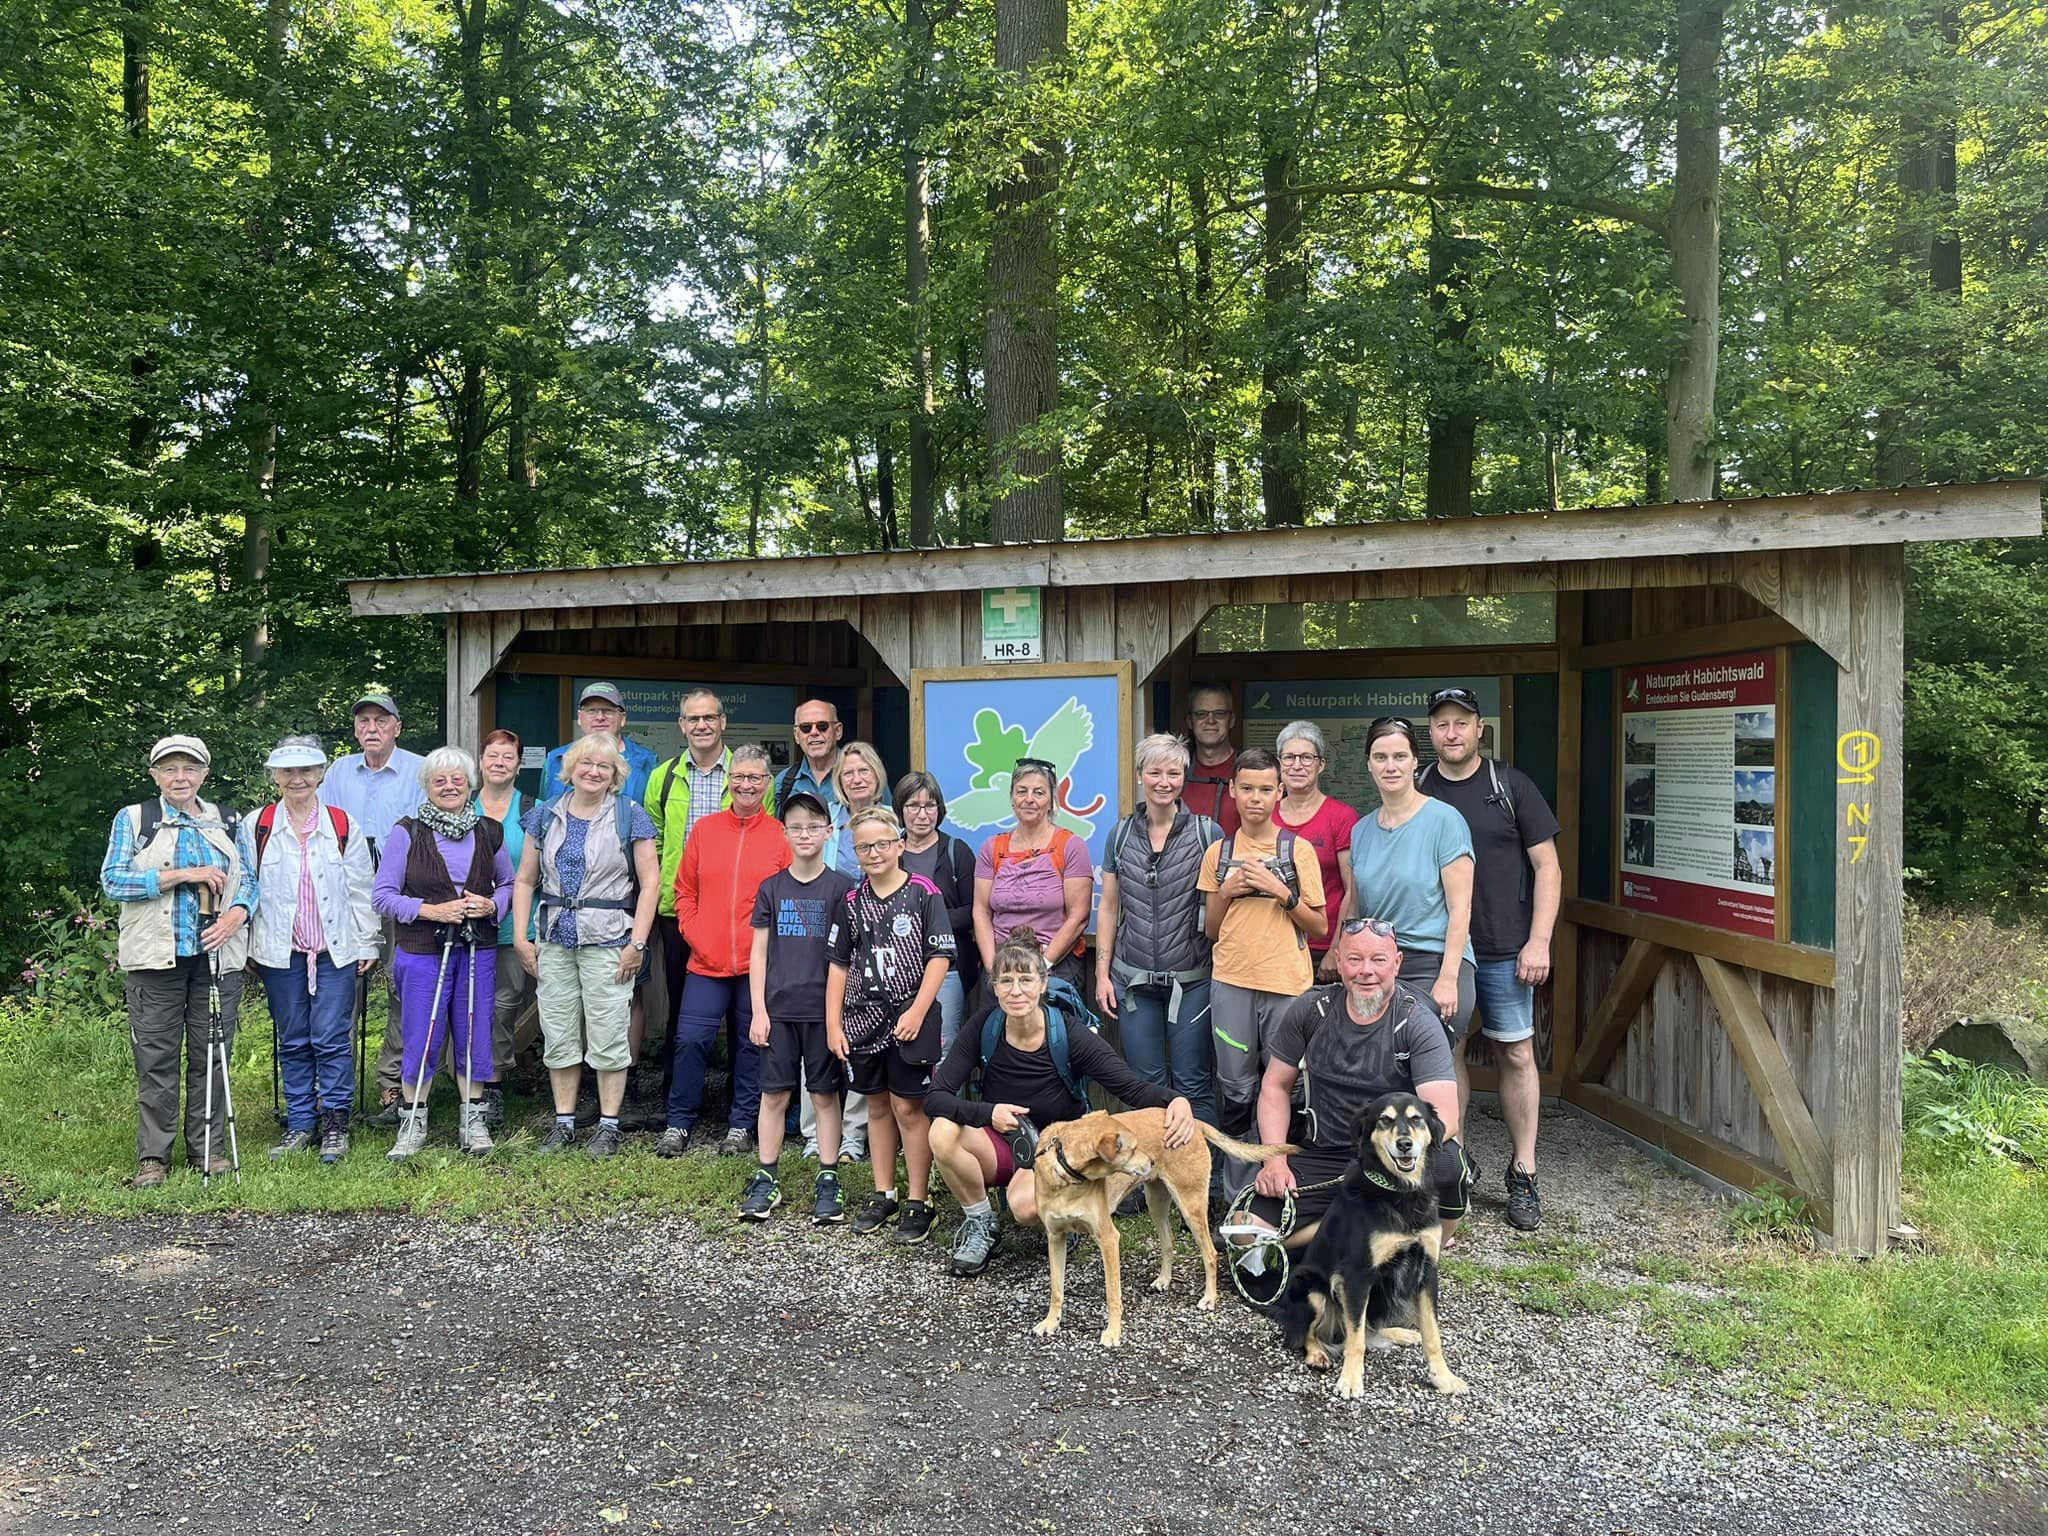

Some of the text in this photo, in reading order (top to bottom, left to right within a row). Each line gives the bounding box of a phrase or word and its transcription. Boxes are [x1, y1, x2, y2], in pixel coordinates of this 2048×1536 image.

[994, 643, 1031, 657] HR-8
[1645, 660, 1766, 691] Naturpark Habichtswald
[621, 690, 670, 703] aturpark
[1286, 691, 1432, 710] Naturpark Habicht
[1645, 687, 1738, 705] Entdecken Sie Gudensberg!
[1847, 802, 1871, 826] N
[1847, 836, 1868, 864] 7
[928, 934, 956, 947] QATA
